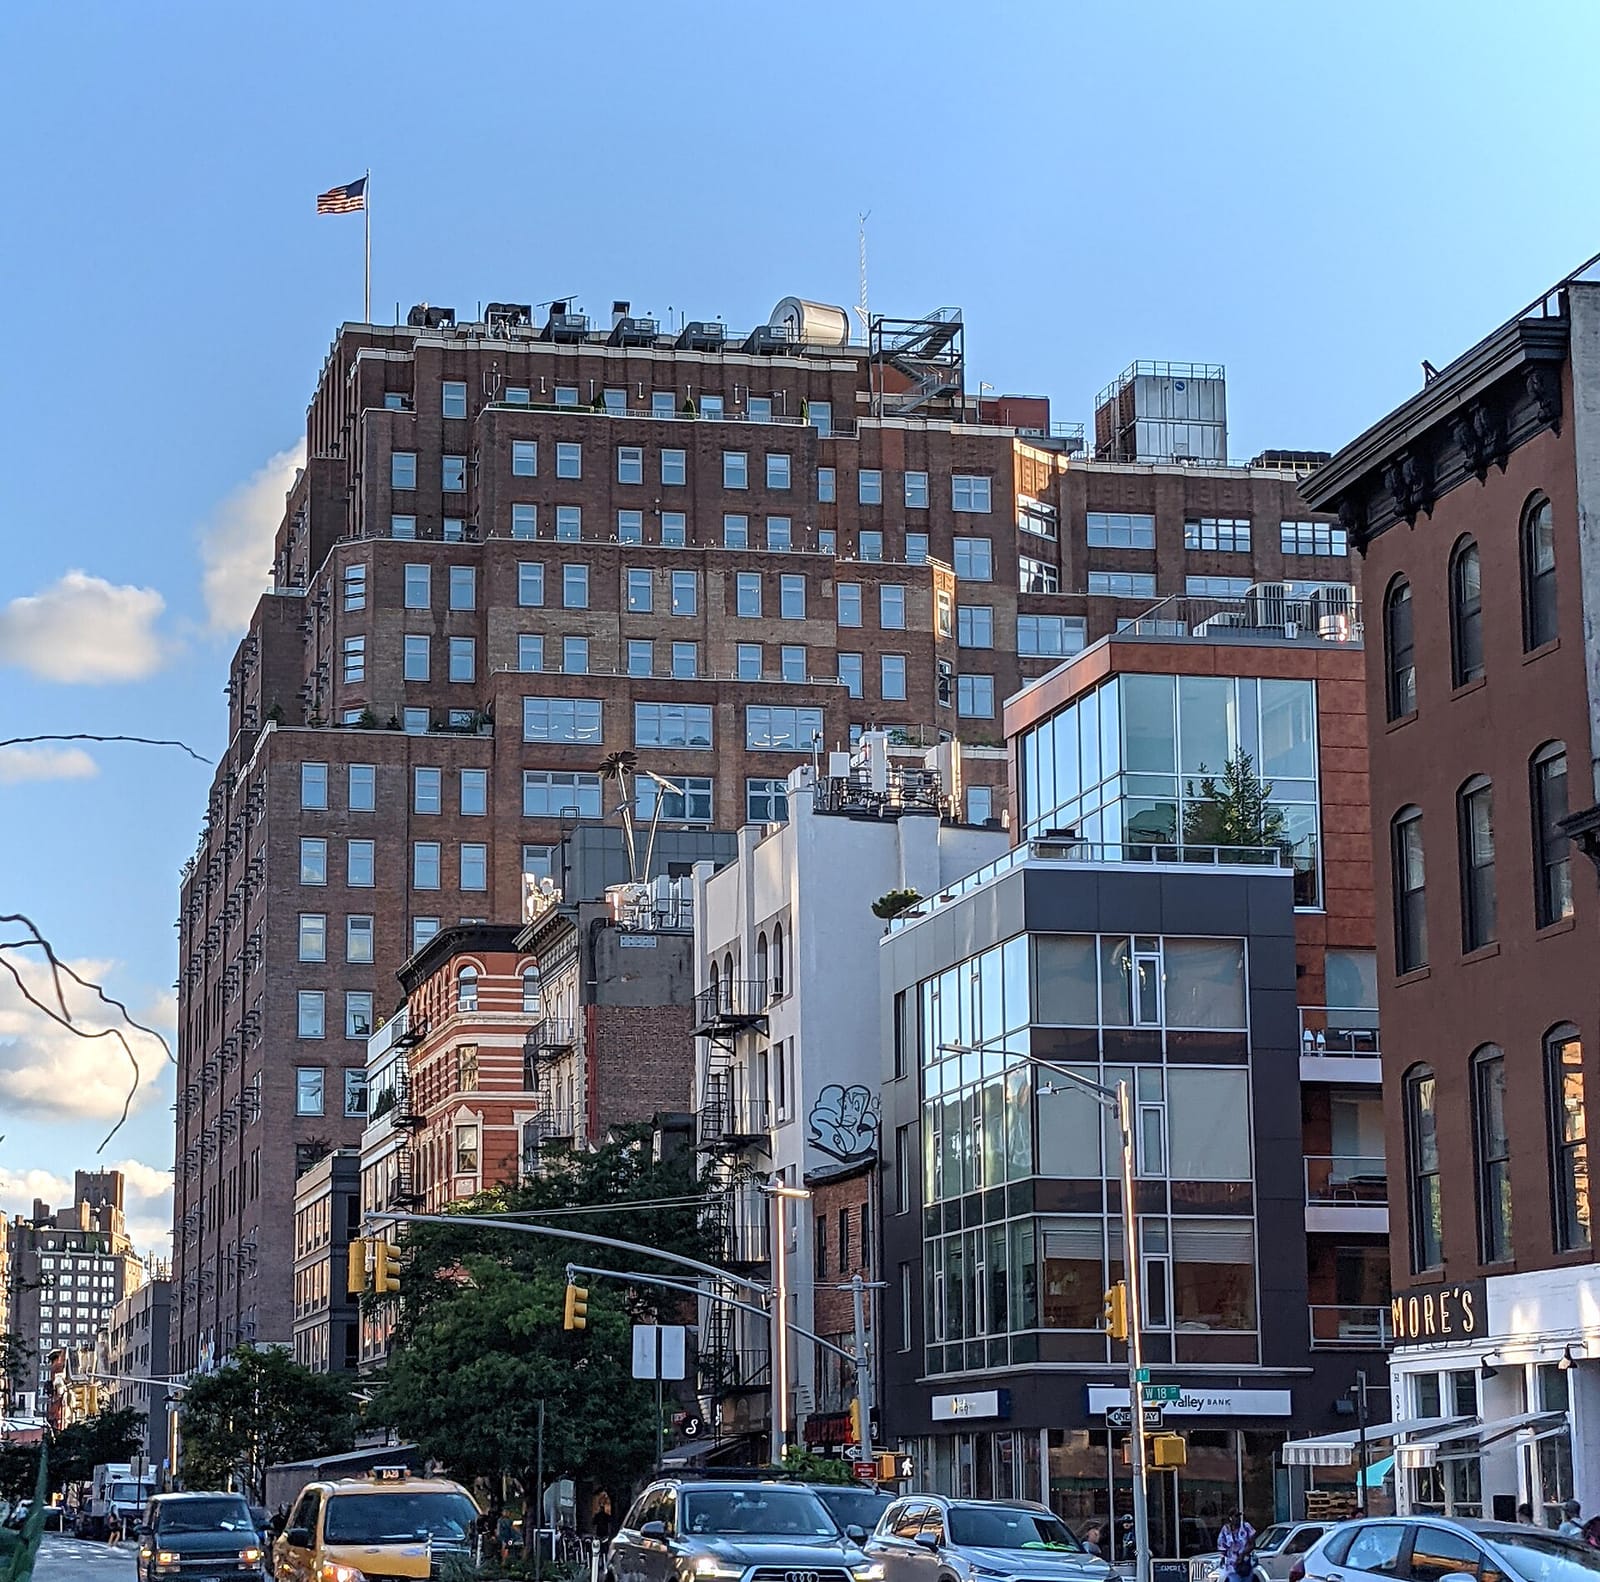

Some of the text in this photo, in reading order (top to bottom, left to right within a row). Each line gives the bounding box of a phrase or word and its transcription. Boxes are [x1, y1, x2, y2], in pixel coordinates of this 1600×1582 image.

[1392, 1288, 1474, 1338] MORE'S
[1145, 1388, 1153, 1399] W
[1157, 1387, 1167, 1399] 18
[1207, 1398, 1231, 1406] BANK
[1114, 1412, 1157, 1421] ONE AY
[685, 1418, 699, 1435] S
